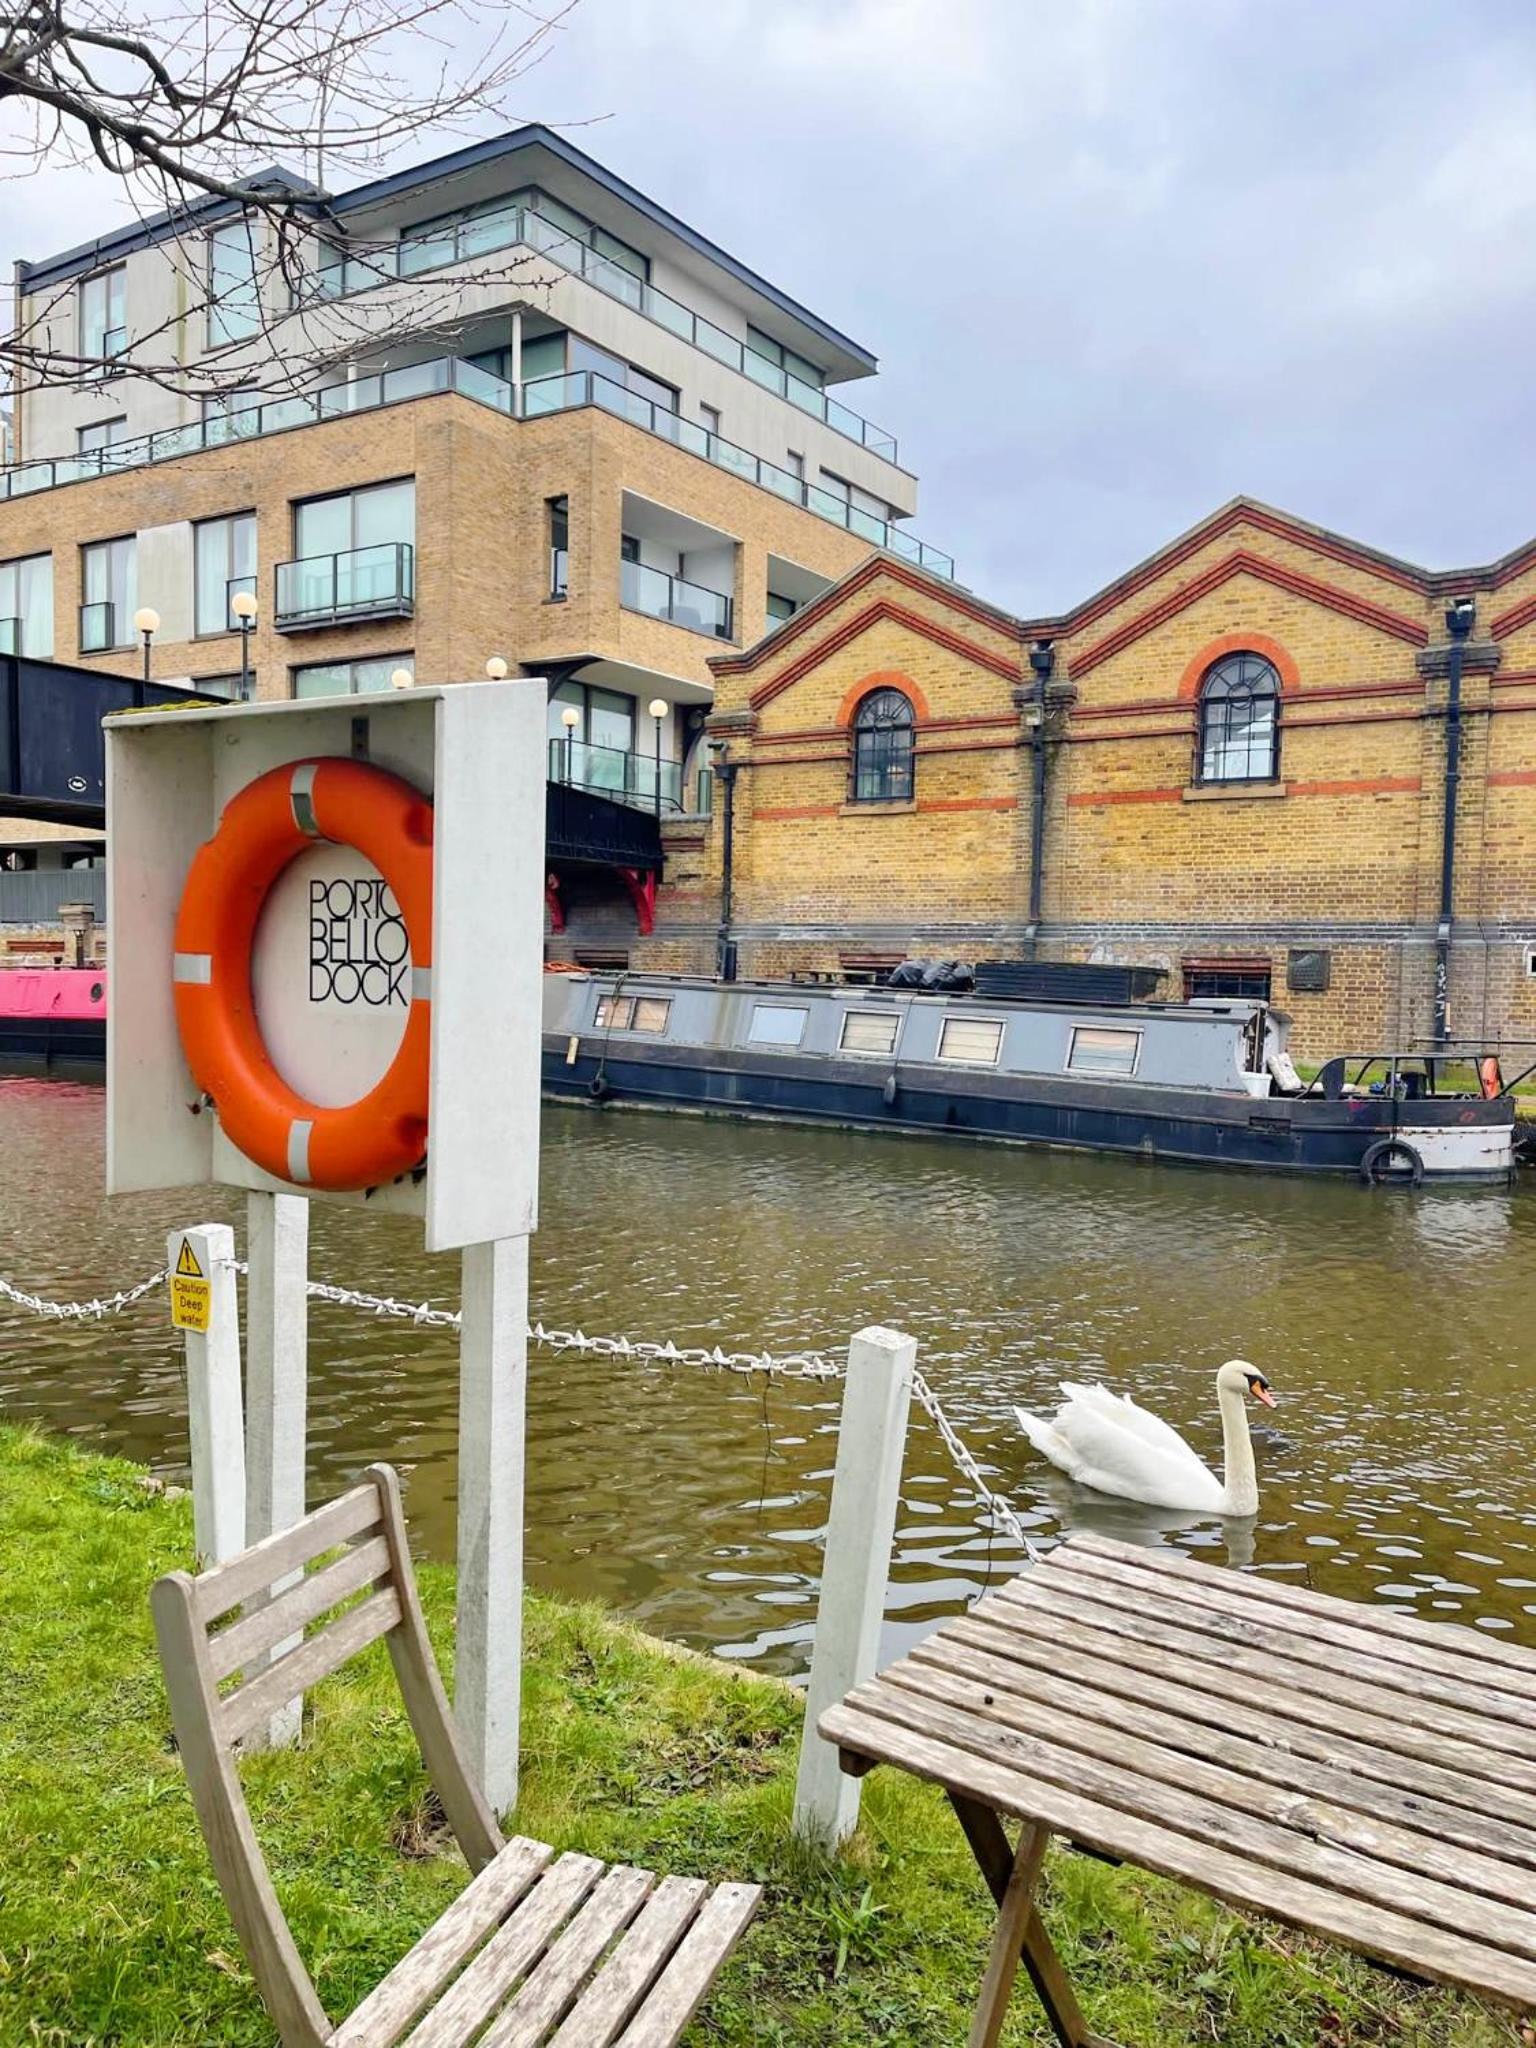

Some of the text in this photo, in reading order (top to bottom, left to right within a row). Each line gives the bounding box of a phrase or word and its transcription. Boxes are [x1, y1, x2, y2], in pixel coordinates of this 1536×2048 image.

[309, 879, 403, 919] PORTO
[309, 918, 409, 965] BELLO
[309, 961, 409, 1007] DOCK
[174, 1279, 208, 1295] Caution
[180, 1295, 202, 1311] Deep
